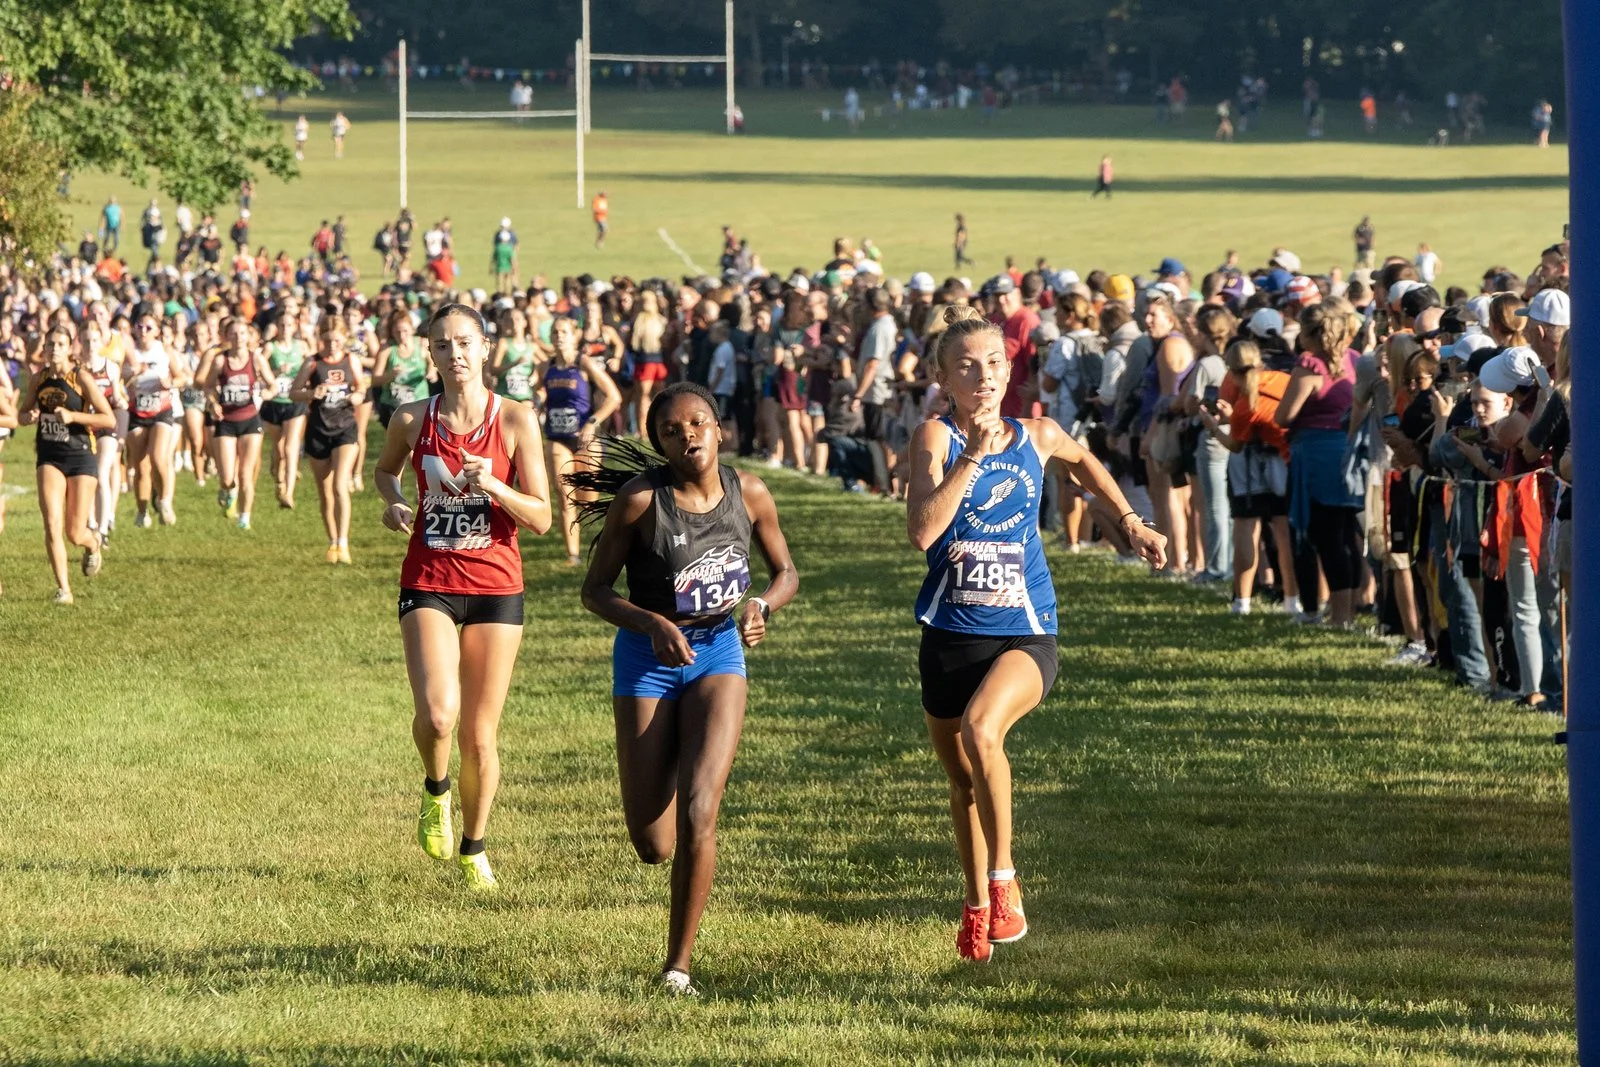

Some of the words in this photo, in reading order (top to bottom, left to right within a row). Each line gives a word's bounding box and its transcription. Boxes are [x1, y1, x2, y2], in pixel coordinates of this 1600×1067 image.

[41, 422, 67, 434] 2105
[421, 454, 493, 498] M
[991, 461, 1019, 474] RIVER
[1018, 469, 1036, 498] RIDGE
[445, 505, 465, 513] INVITE
[964, 511, 984, 530] EAST
[425, 512, 488, 536] 2764
[953, 562, 1021, 590] 1485
[690, 579, 743, 611] 134
